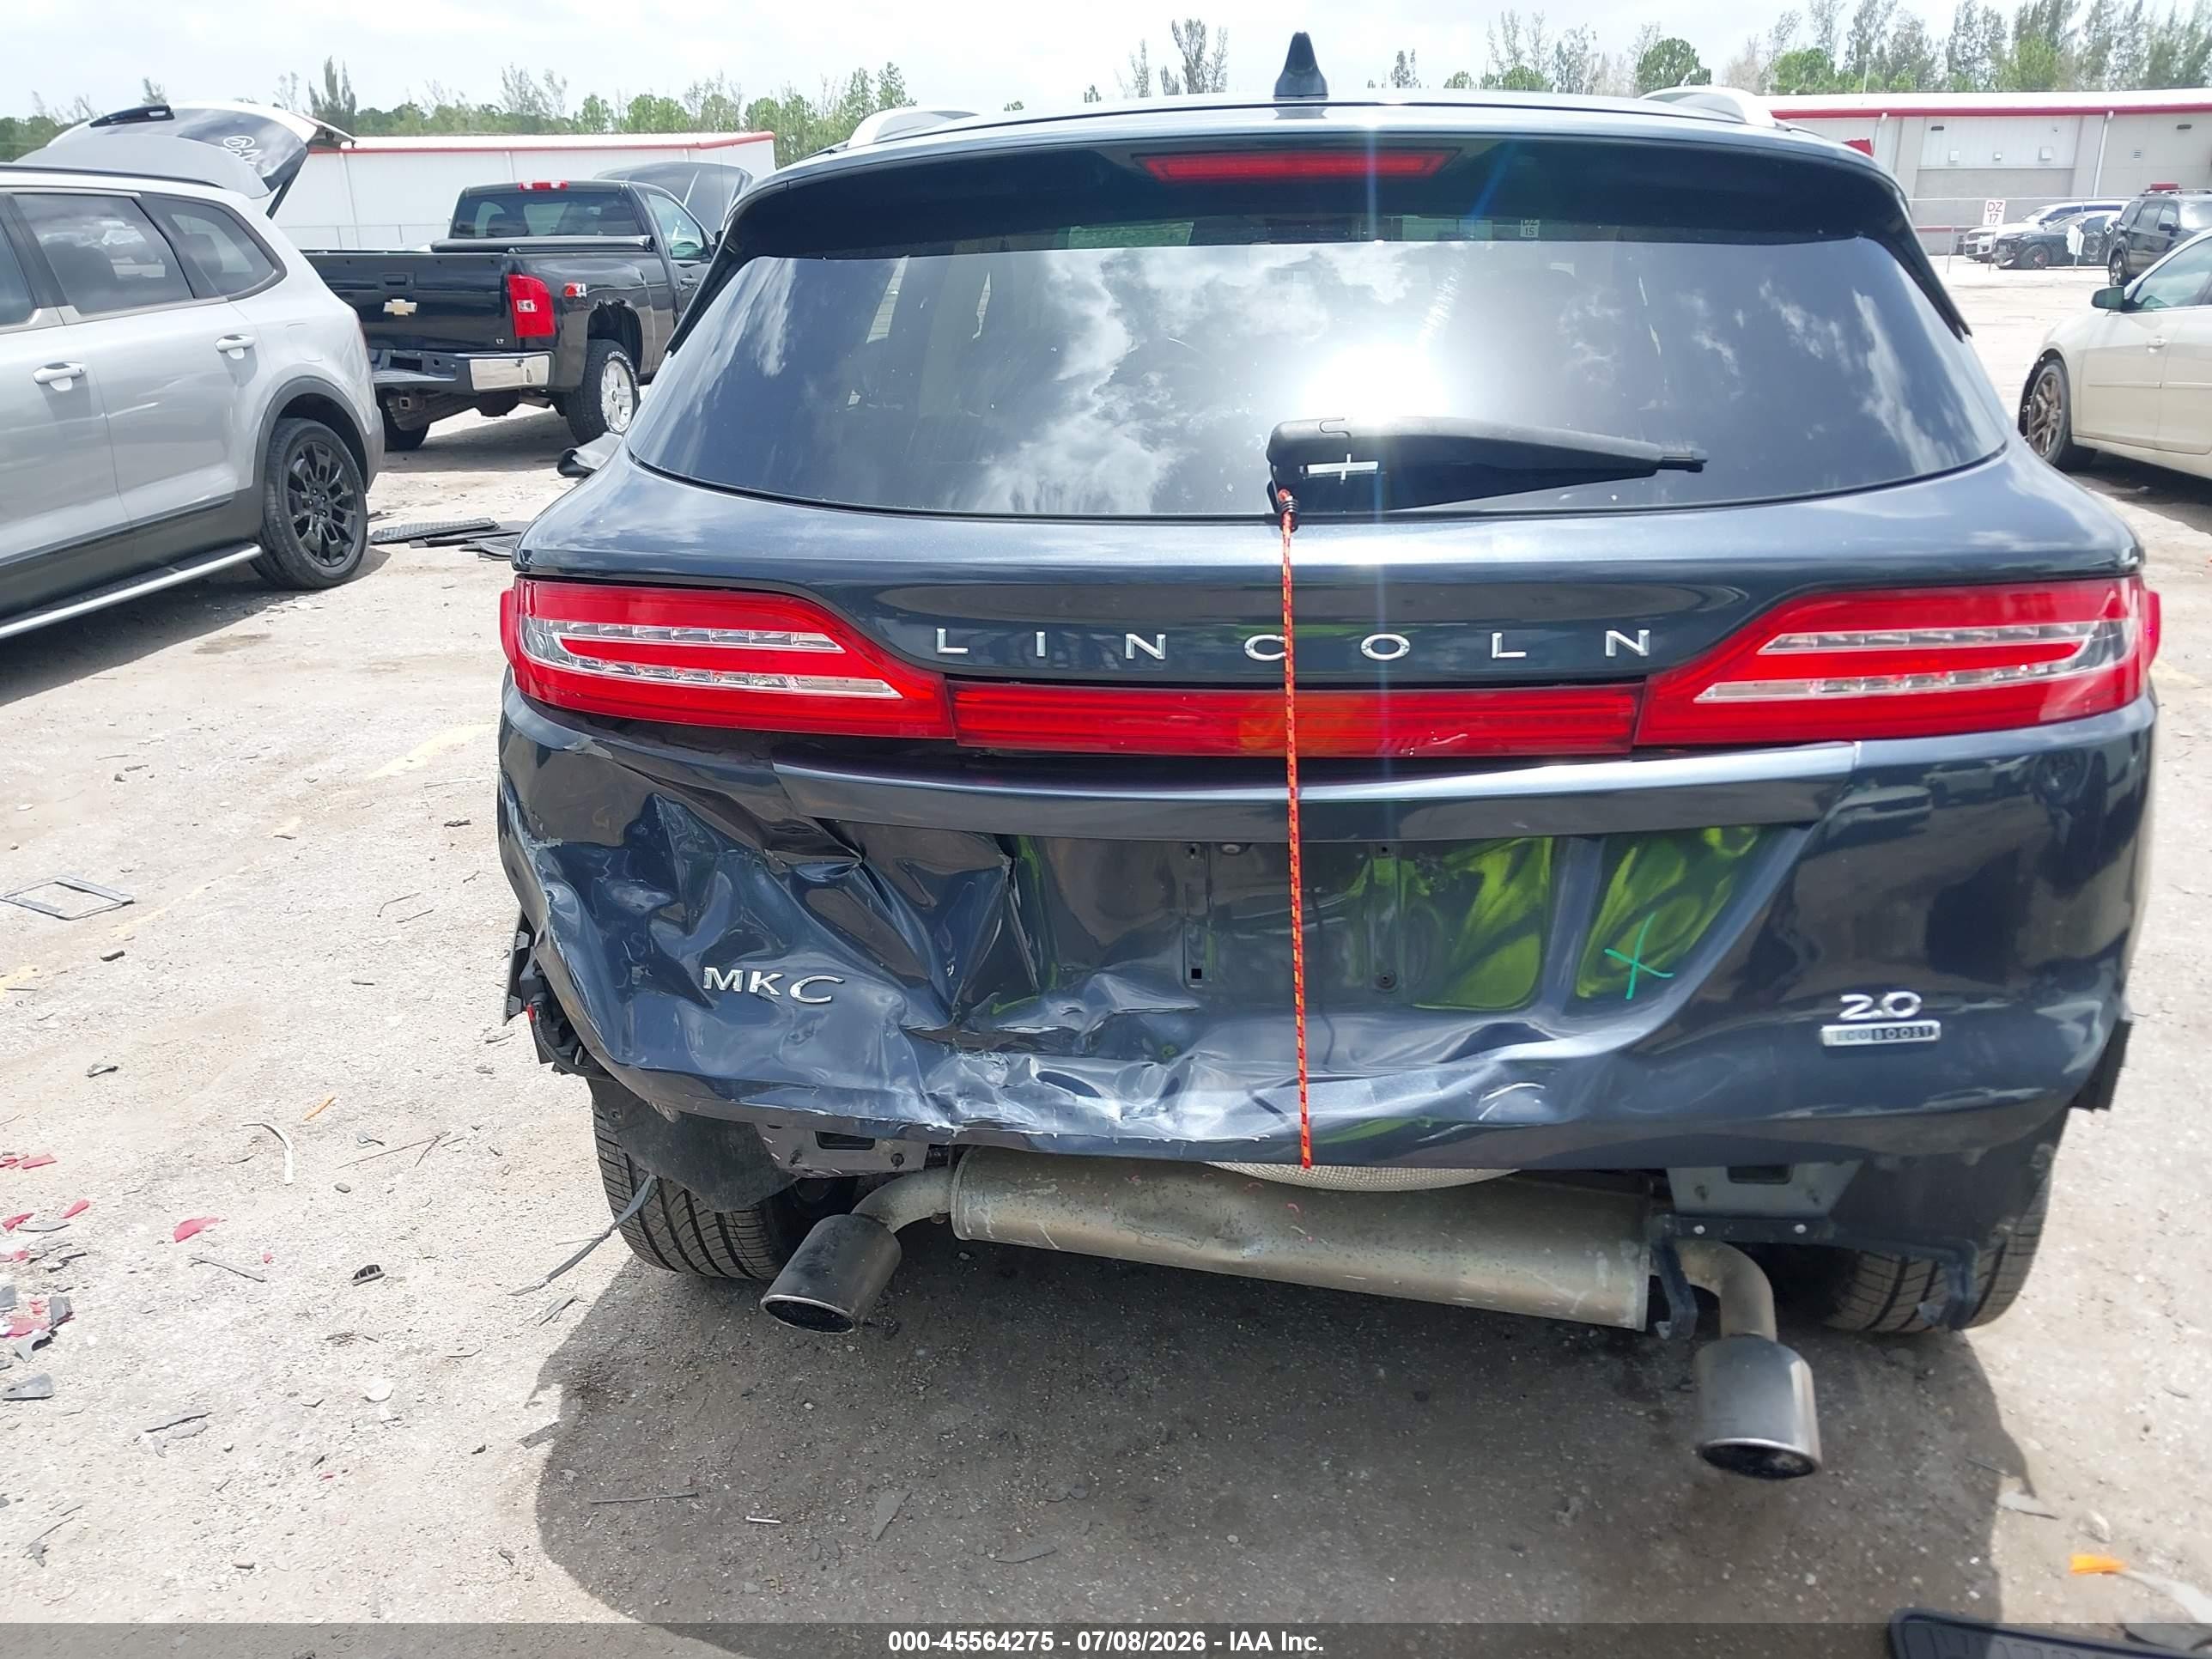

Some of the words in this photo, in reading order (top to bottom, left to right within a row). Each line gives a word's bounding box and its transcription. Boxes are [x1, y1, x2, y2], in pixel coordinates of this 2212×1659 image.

[1987, 201, 2003, 212] DZ
[1989, 213, 1999, 224] 17
[937, 627, 1650, 661] LINCOLN
[702, 967, 845, 1004] MKC
